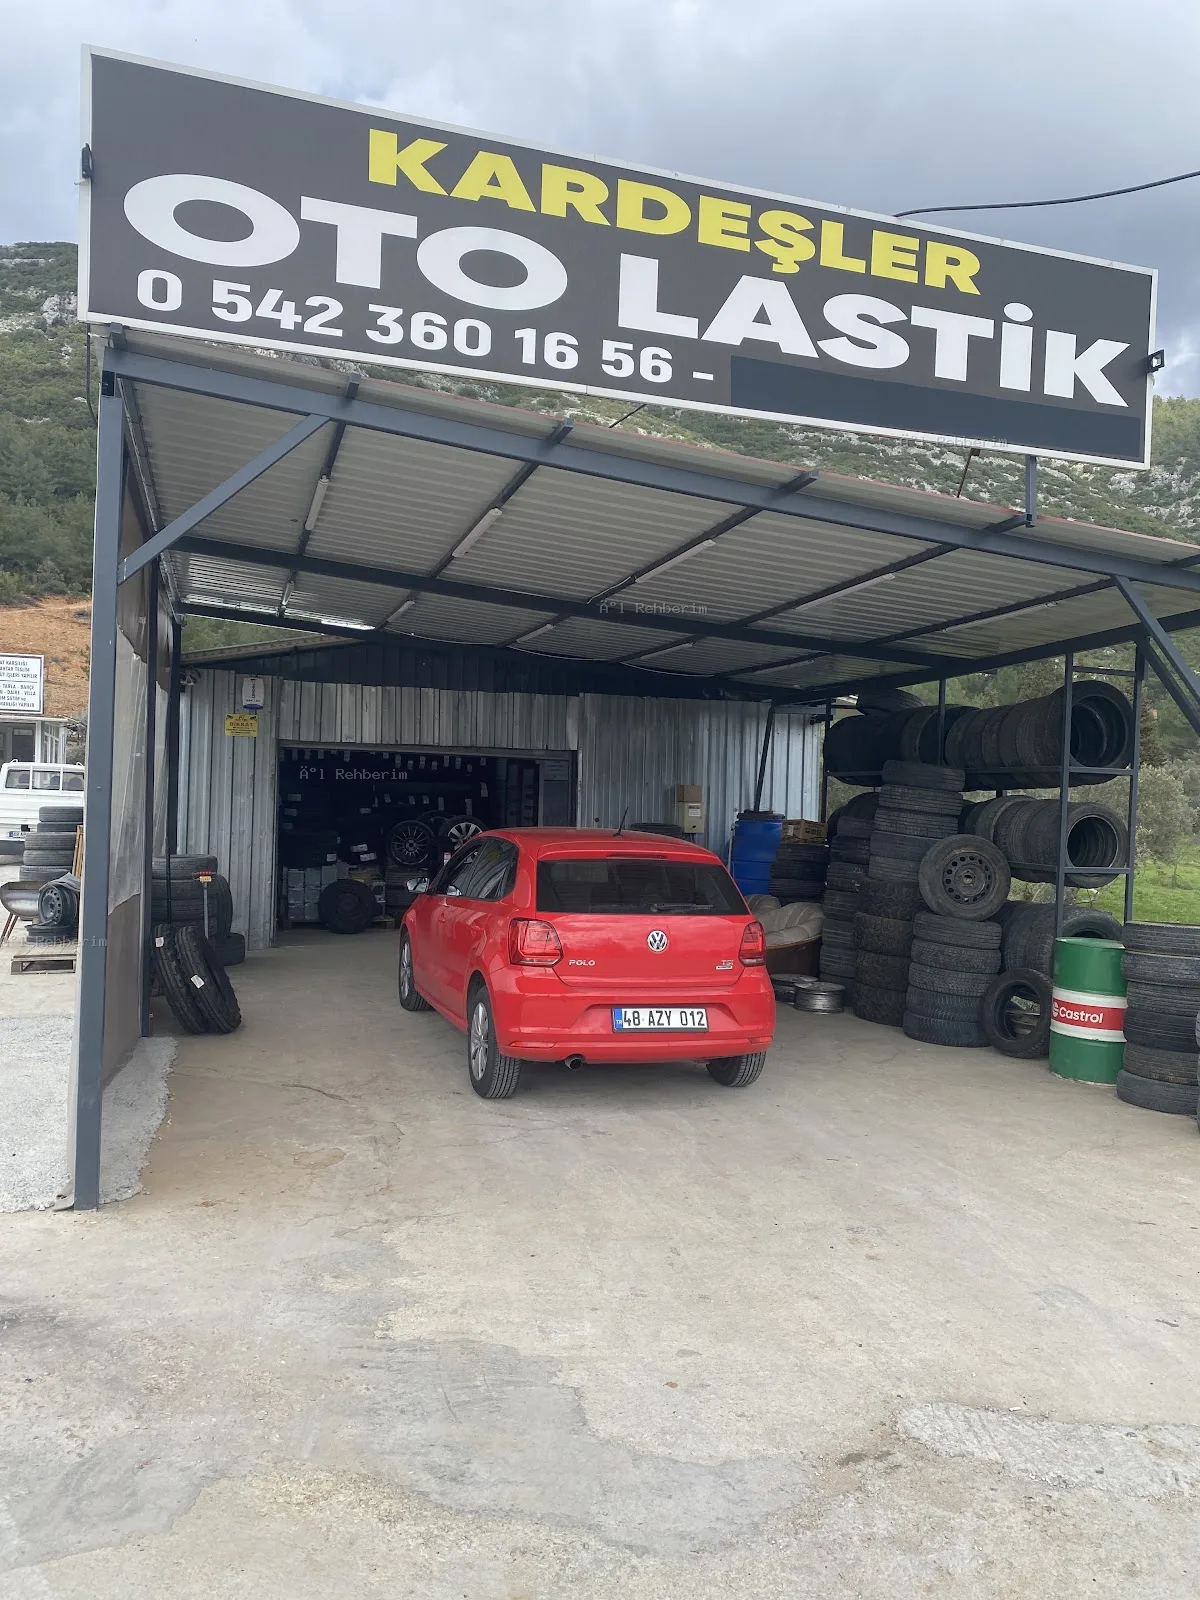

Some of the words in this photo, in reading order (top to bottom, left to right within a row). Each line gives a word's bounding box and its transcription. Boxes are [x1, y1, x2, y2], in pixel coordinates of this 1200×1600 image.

[369, 130, 980, 294] KARDEŞLER
[124, 174, 567, 310] OTO
[618, 253, 1129, 407] LASTİK
[138, 269, 182, 311] 0
[212, 280, 343, 337] 542
[366, 304, 491, 356] 360
[515, 328, 578, 369] 16
[602, 340, 672, 383] 56
[623, 1010, 641, 1026] 48
[648, 1010, 672, 1026] AZY
[680, 1010, 705, 1026] 012
[1060, 1006, 1104, 1024] Castrol
